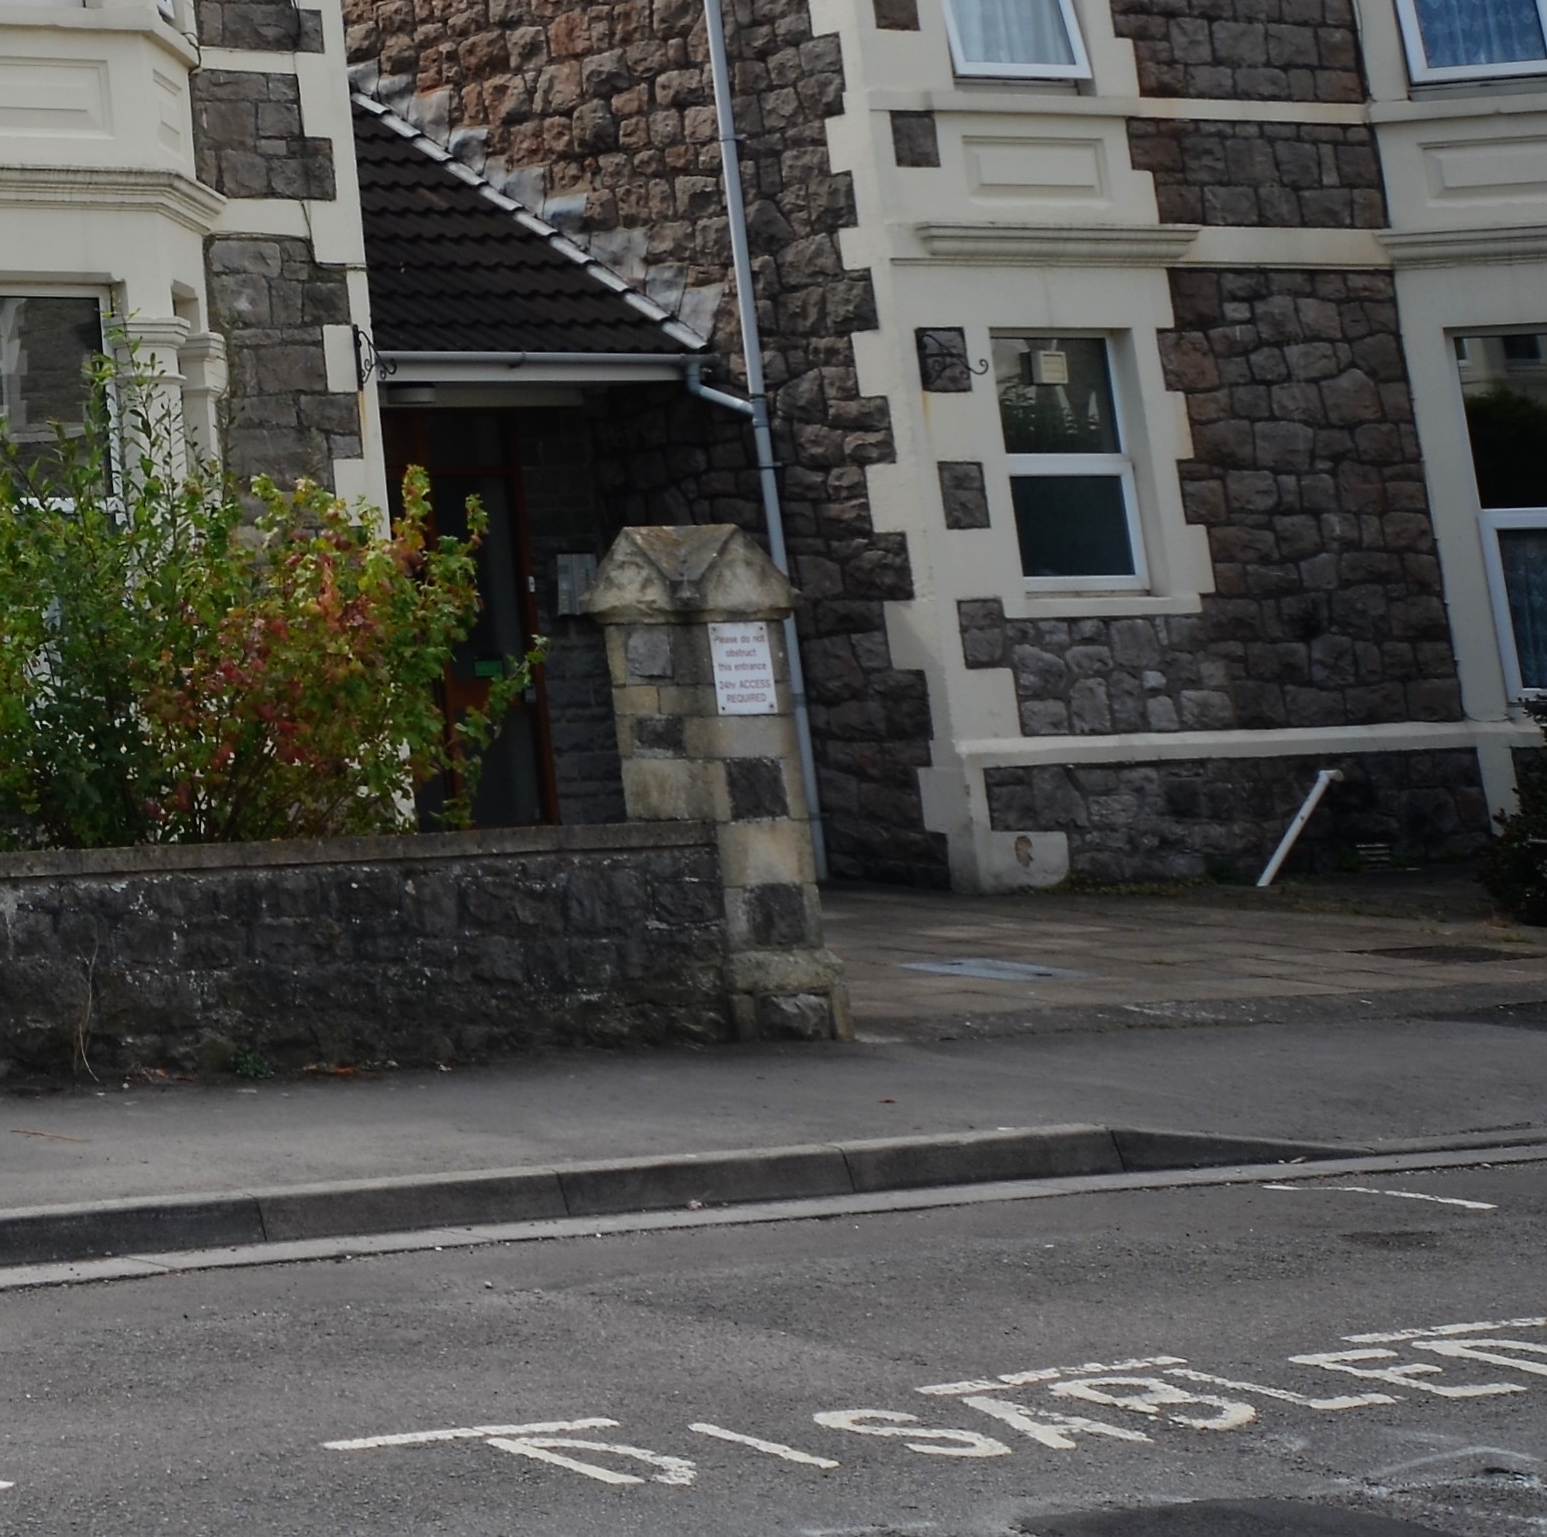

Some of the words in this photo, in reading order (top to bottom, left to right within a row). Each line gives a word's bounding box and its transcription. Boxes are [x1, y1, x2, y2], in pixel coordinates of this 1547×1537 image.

[740, 634, 750, 643] do
[752, 634, 765, 643] not
[725, 649, 757, 657] obstruct
[718, 663, 732, 671] this
[734, 662, 767, 671] entrance
[739, 679, 771, 689] ACCESS
[726, 693, 767, 703] REQUIRED
